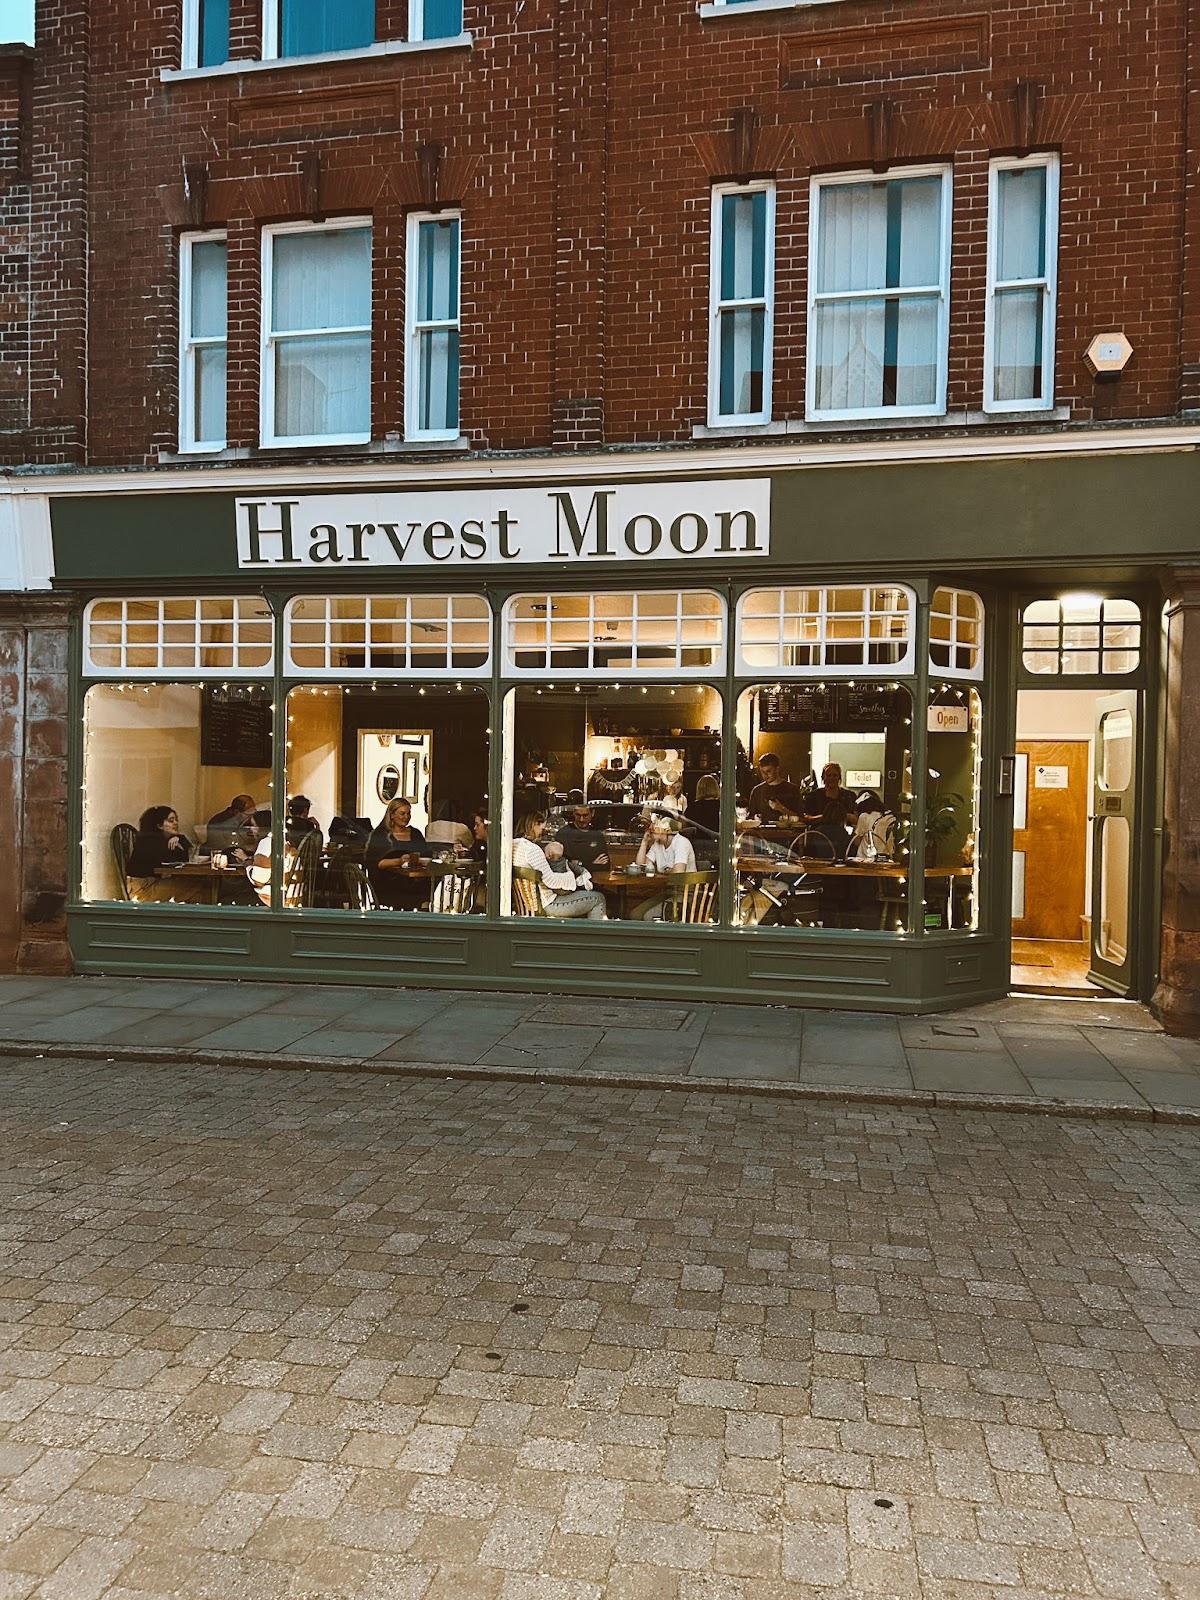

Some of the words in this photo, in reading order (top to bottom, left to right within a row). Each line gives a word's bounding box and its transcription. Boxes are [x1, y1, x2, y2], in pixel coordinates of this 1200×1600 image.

[239, 500, 521, 563] Harvest
[547, 490, 764, 557] Moon
[937, 711, 959, 727] Open
[853, 772, 872, 782] Toilet
